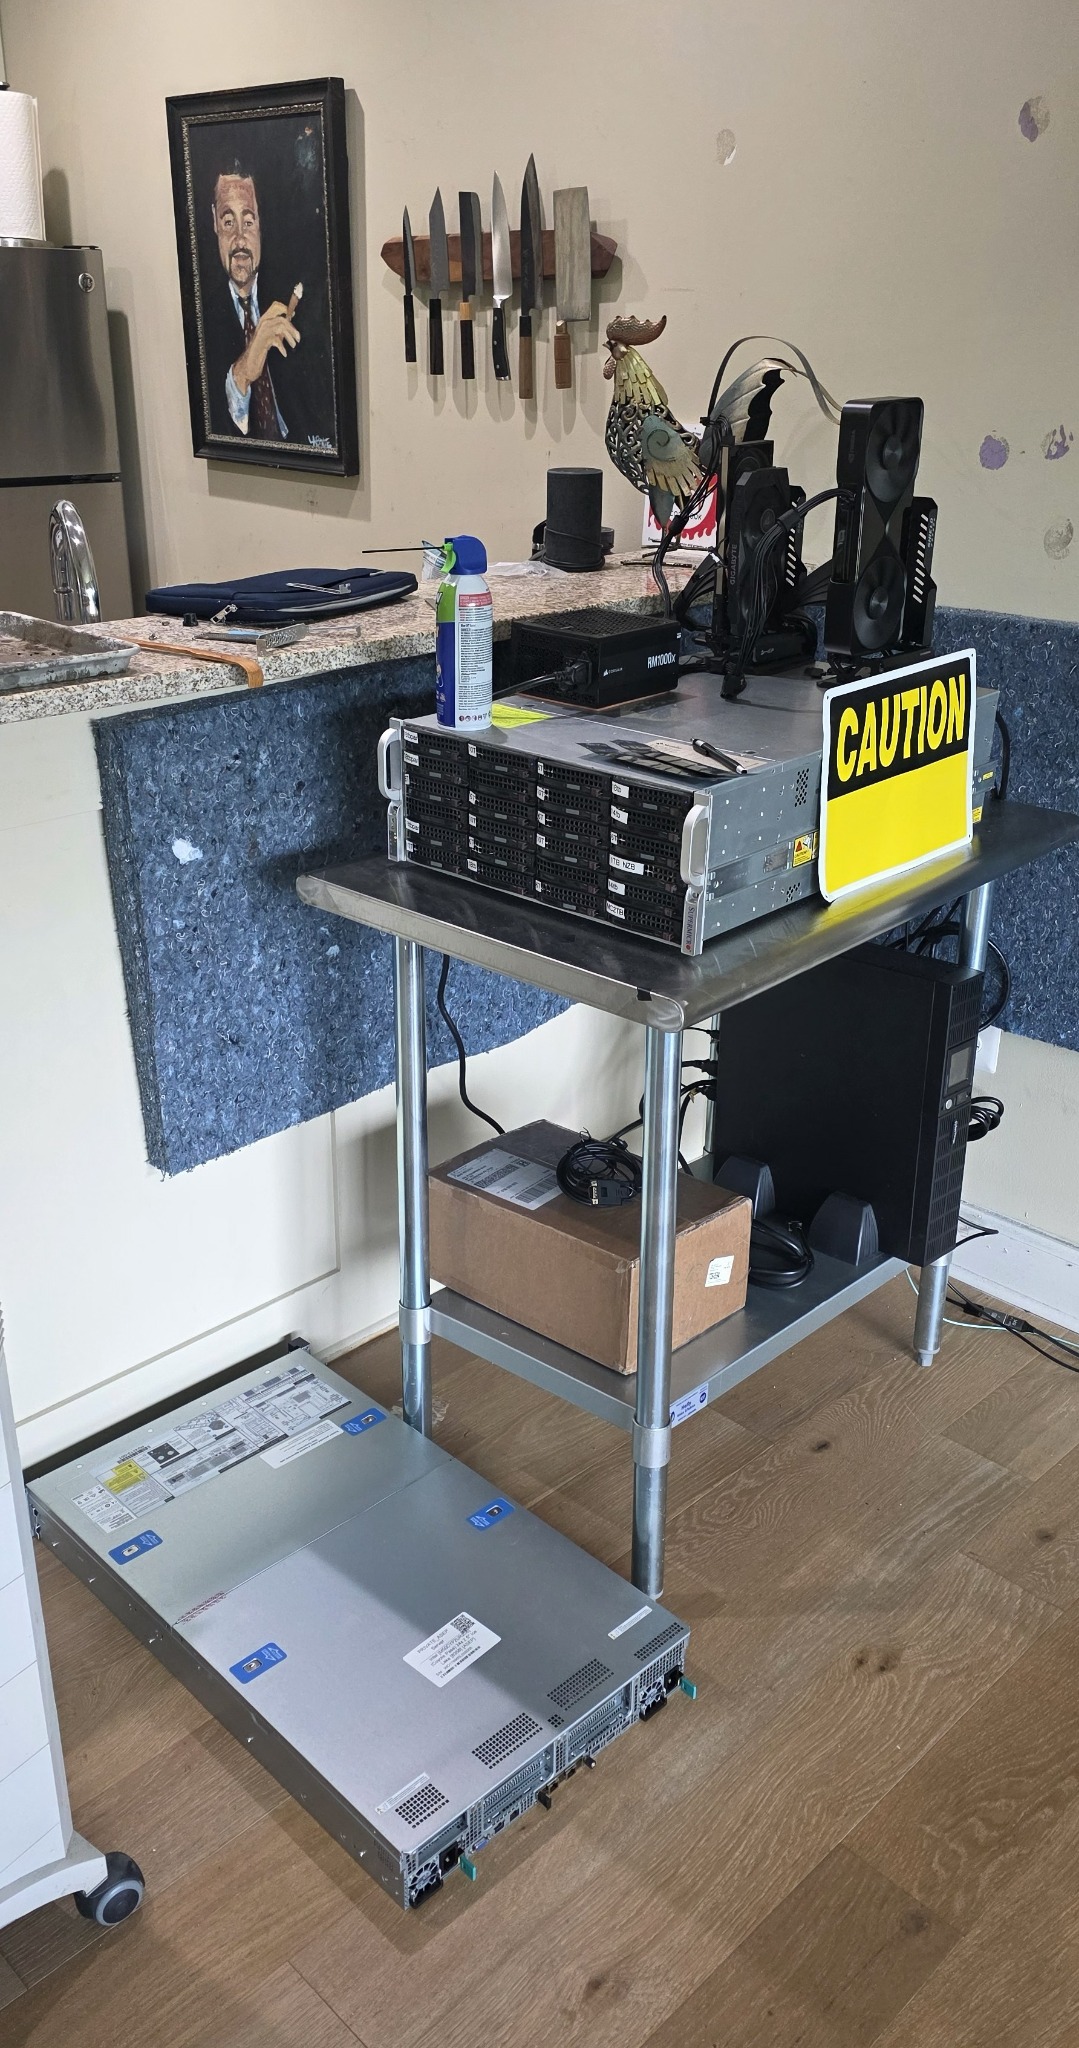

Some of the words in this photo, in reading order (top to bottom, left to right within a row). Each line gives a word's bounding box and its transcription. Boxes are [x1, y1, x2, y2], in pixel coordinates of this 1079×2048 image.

[729, 544, 738, 585] GIGABYTE
[647, 652, 677, 669] RM1000x
[837, 674, 965, 782] CAUTION
